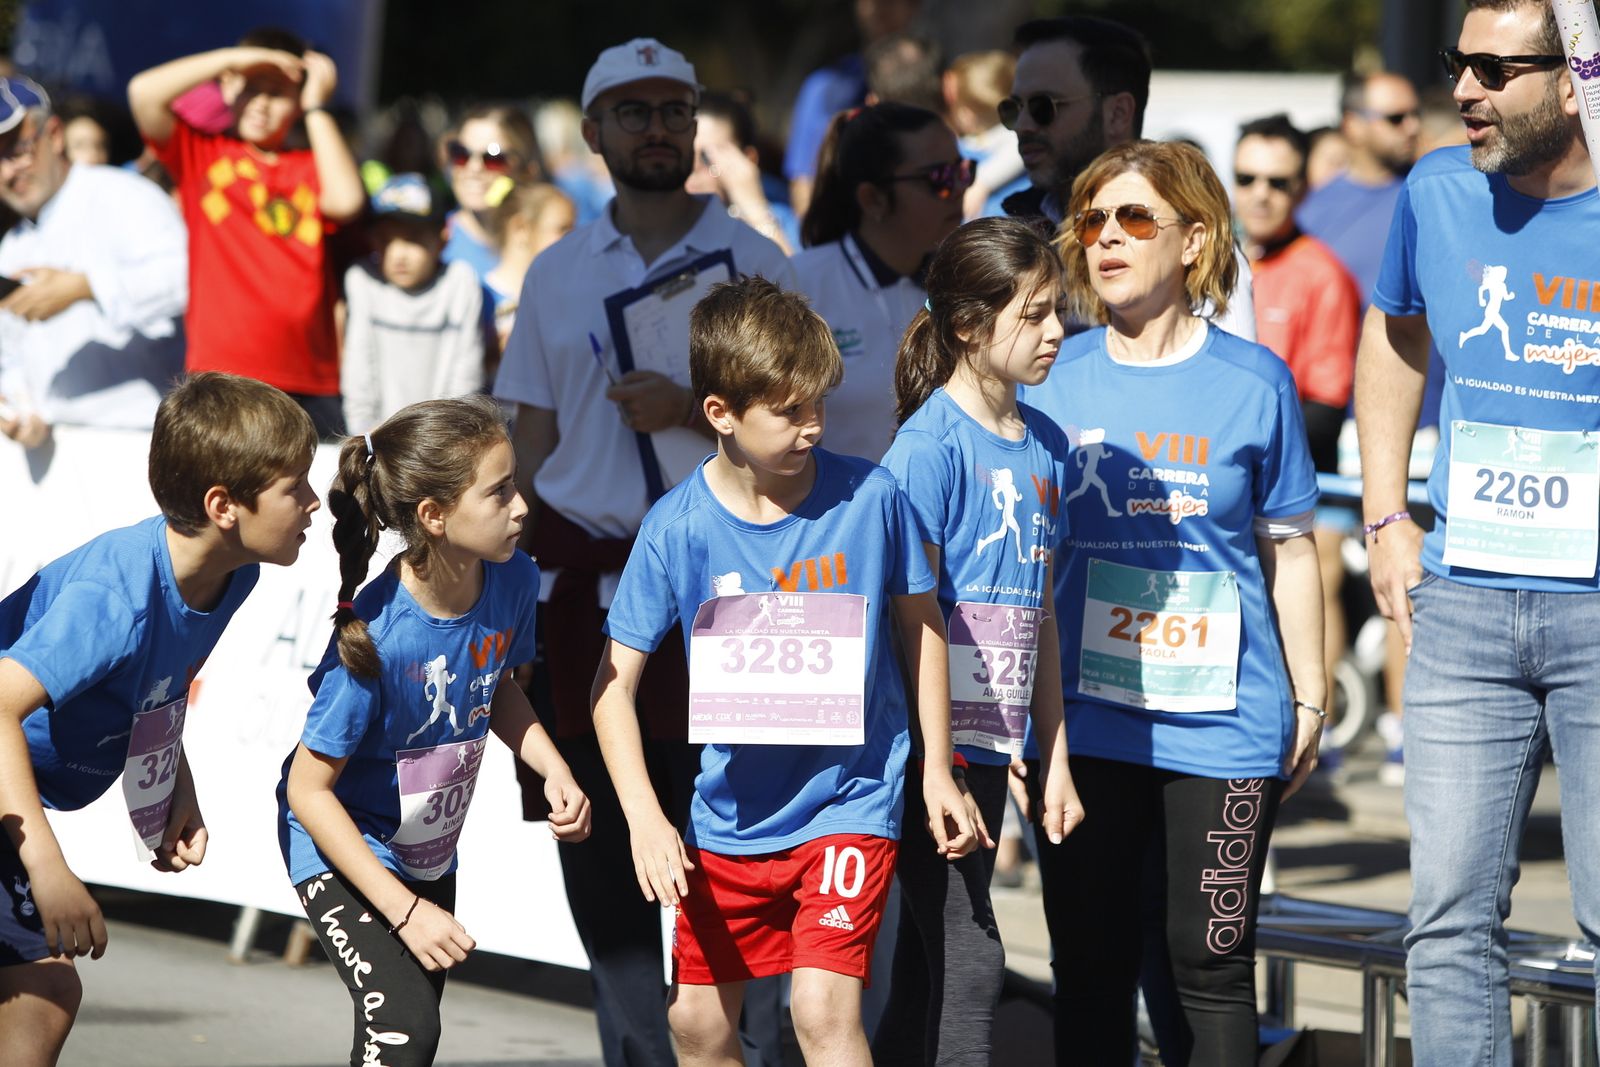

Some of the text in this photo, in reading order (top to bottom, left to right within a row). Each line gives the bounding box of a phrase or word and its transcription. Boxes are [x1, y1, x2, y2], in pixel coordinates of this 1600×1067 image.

[1454, 376, 1600, 404] LA IGUALDAD ES NUESTRA MET
[1135, 431, 1210, 466] VIII
[1128, 467, 1210, 487] CARRERA
[1474, 468, 1569, 509] 2260
[1496, 507, 1535, 520] RAMON
[1121, 541, 1134, 551] ES
[1136, 541, 1183, 551] NUESTRA
[770, 552, 848, 592] VIII
[778, 595, 804, 606] VIII
[966, 584, 979, 593] LA
[1108, 606, 1209, 648] 2261
[720, 637, 834, 675] 3283
[1138, 647, 1177, 659] PAOLA
[983, 687, 1004, 699] ANA
[819, 846, 866, 899] 10
[818, 918, 855, 931] adidas
[320, 904, 373, 989] have
[363, 991, 385, 1022] a
